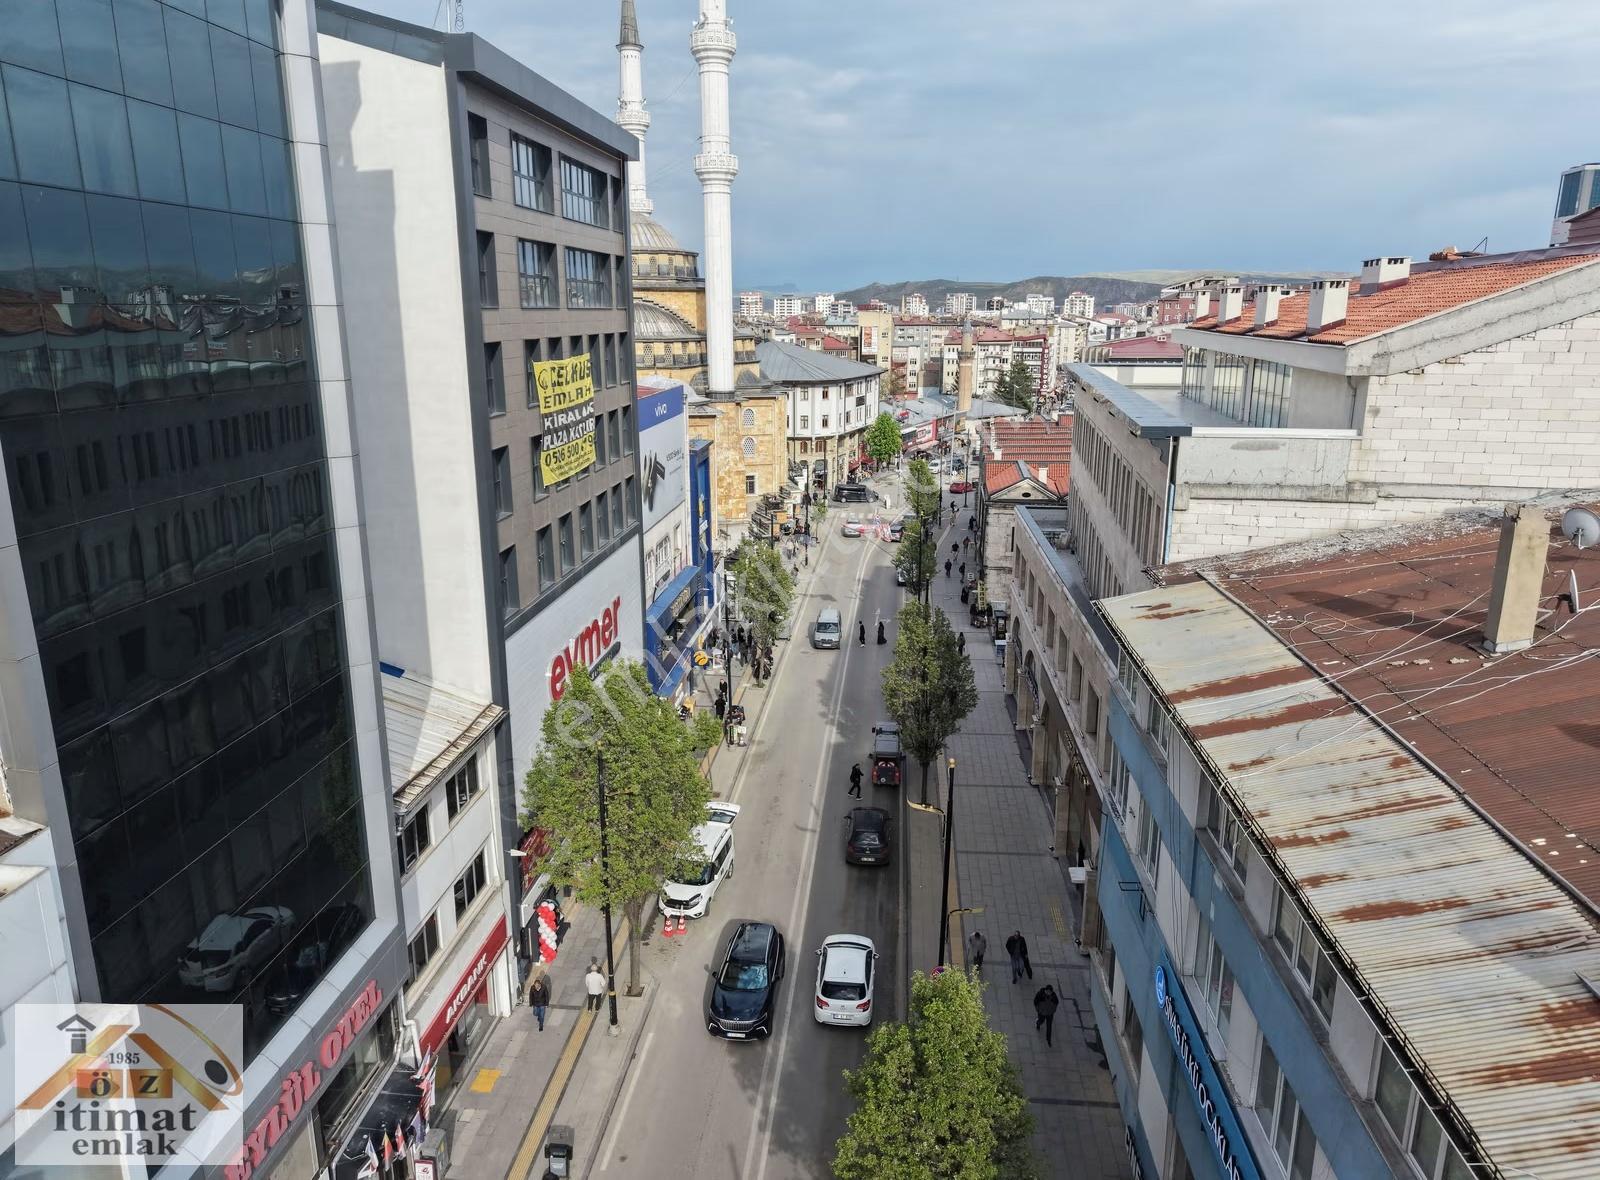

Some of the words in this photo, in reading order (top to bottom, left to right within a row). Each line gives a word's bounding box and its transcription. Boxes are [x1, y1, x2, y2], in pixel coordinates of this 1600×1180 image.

[654, 403, 667, 417] vivo
[320, 978, 383, 1069] OTEL
[446, 952, 488, 1024] AKBANK
